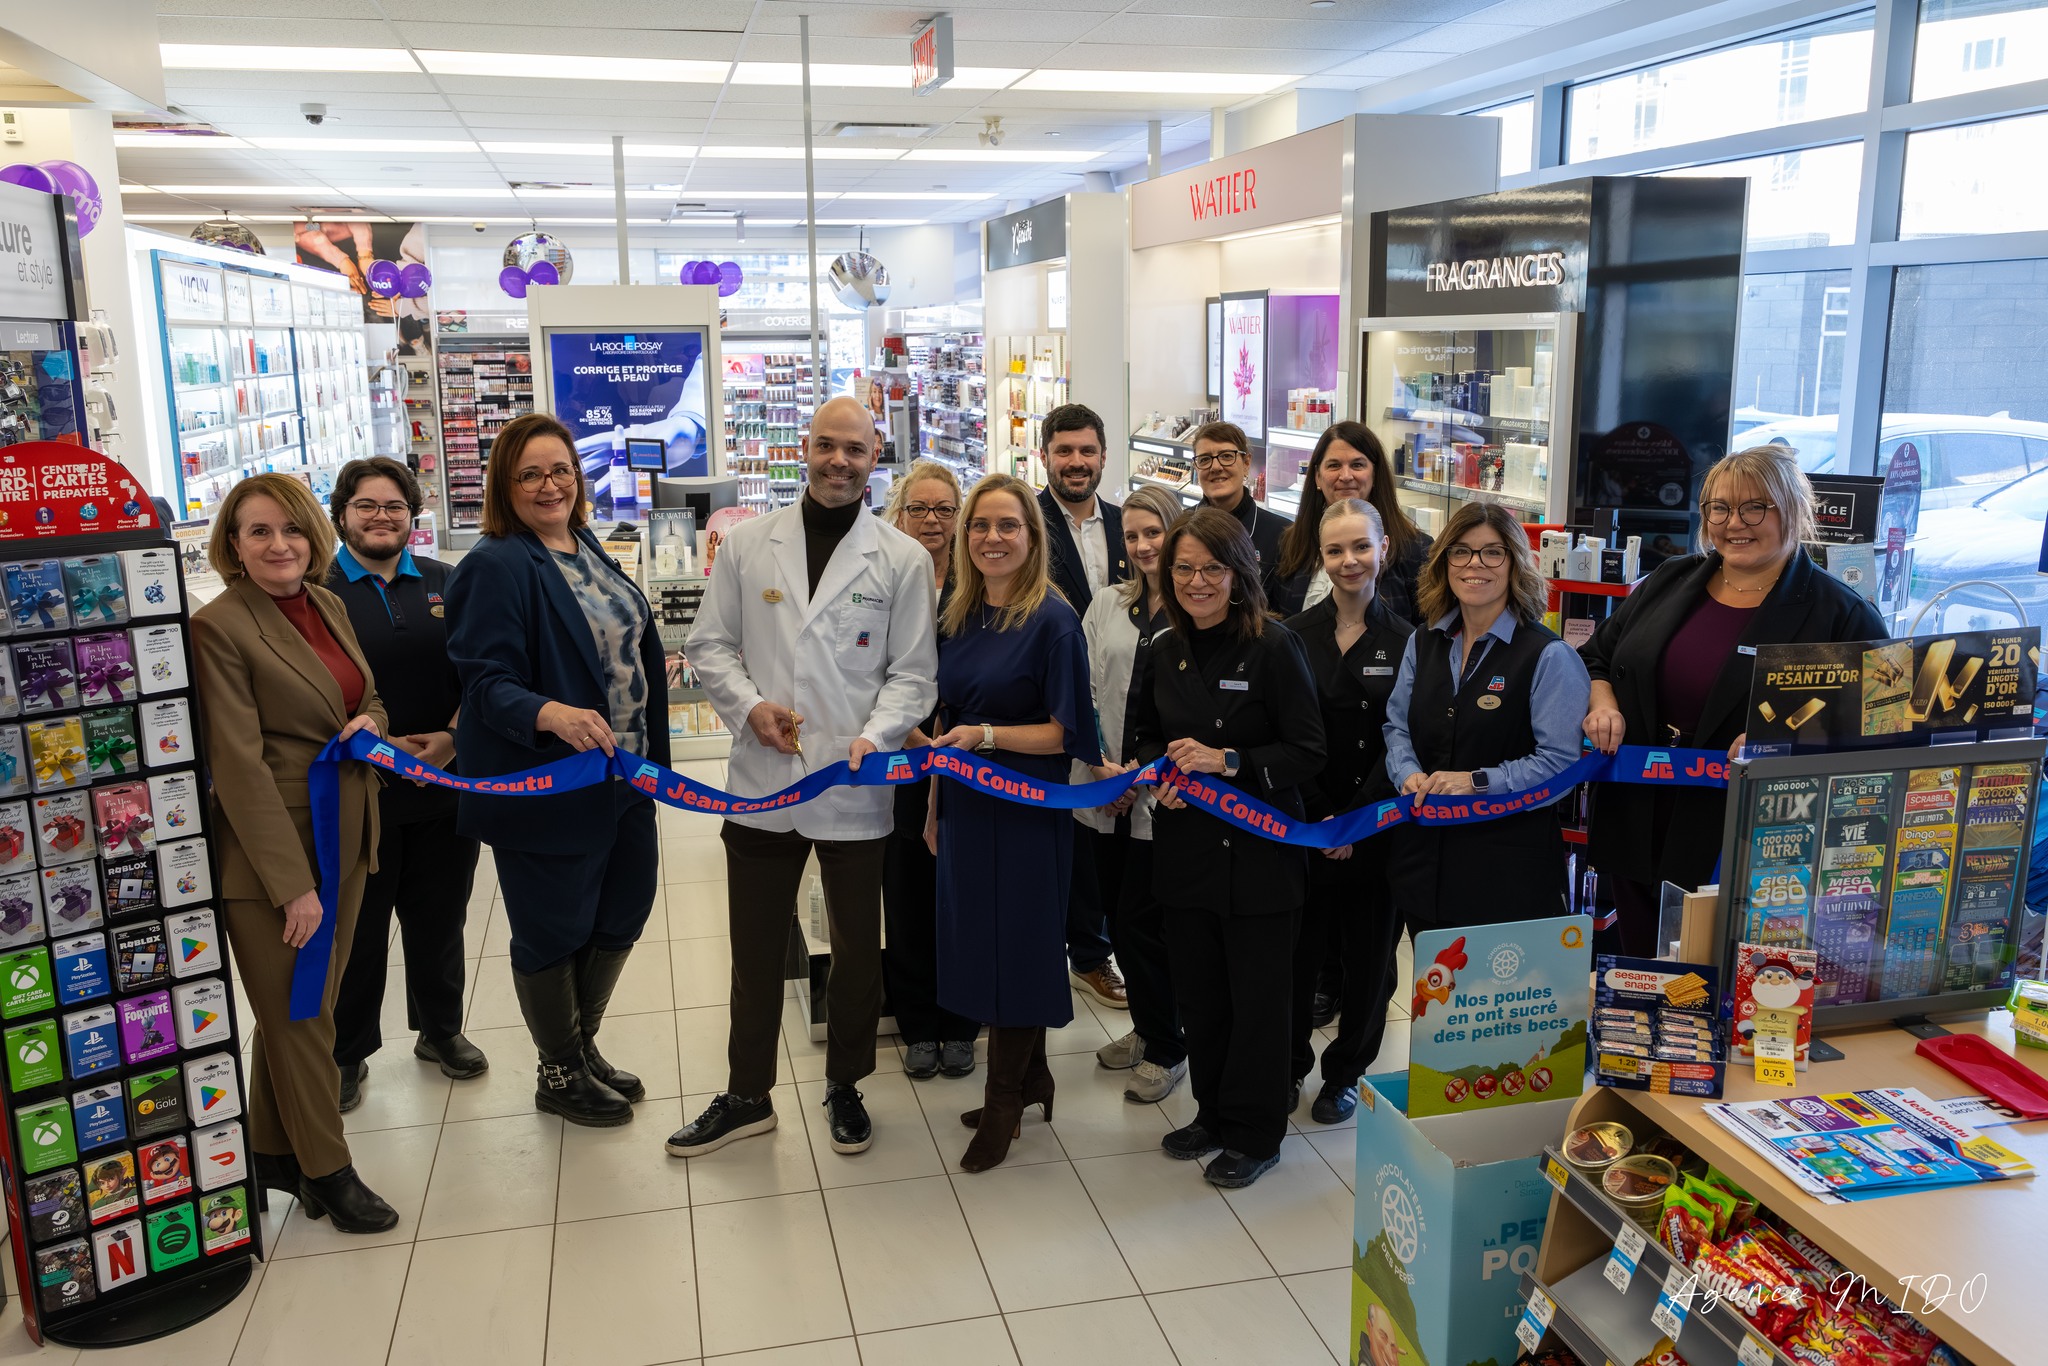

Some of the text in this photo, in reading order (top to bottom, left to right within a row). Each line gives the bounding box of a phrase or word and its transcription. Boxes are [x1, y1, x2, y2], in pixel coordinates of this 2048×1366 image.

[1190, 168, 1257, 221] WATIER
[18, 261, 53, 289] et style
[1426, 252, 1565, 292] FRAGRANCES
[179, 275, 209, 304] VICHY
[372, 278, 392, 289] moi
[1229, 315, 1261, 335] WATIER
[15, 329, 39, 344] Lecture
[590, 342, 663, 352] LA ROCHE POSAY
[573, 363, 683, 374] CORRIGE ET PROTÈGE
[608, 373, 650, 382] LA PEAU
[91, 462, 107, 472] DE
[42, 472, 108, 487] CARTES
[43, 484, 110, 500] PRÉPAYÉES
[666, 512, 693, 520] WATIER
[1577, 555, 1590, 571] ck
[28, 573, 42, 585] You
[97, 645, 112, 658] You
[1988, 644, 2021, 667] 20
[1766, 669, 1859, 685] PESANT D'OR
[1987, 674, 2019, 683] LINGOTS
[1985, 682, 2017, 696] D'OR
[405, 764, 553, 793] Jean Coutu
[921, 751, 1046, 801] Jean Coutu
[1942, 772, 1953, 781] As
[1773, 783, 1789, 791] 000
[1978, 788, 1991, 799] 20
[666, 782, 801, 812] Jean Coutu
[1161, 767, 1288, 839] Jean Coutu
[1410, 787, 1551, 820] Jean Coutu
[1910, 794, 1949, 805] SCRABBLE
[1759, 792, 1818, 823] 30X
[1979, 809, 2020, 817] MILLIONS
[1756, 837, 1761, 846] 1
[1762, 835, 1781, 845] 000
[1783, 833, 1803, 844] 000
[1844, 826, 1866, 841] VIE
[1905, 829, 1936, 843] bingo
[1762, 843, 1802, 858] ULTRA
[1831, 851, 1876, 866] ARGENT
[1965, 855, 2004, 867] RETOUR
[108, 861, 148, 876] ROBLOX
[1760, 874, 1801, 887] GIGA
[1829, 875, 1873, 887] MEGA
[1752, 884, 1807, 905] 360
[1894, 890, 1942, 903] CONNEXION
[1826, 900, 1873, 914] AMÉTHYSTE
[148, 925, 161, 933] $25
[173, 921, 211, 935] Google Play
[119, 935, 161, 950] ROBLOX
[1487, 942, 1526, 961] CHOCOLATERIE
[71, 971, 96, 980] PlayStation
[1614, 971, 1658, 982] sesame
[1624, 981, 1657, 991] snaps
[6, 992, 51, 1007] CARTE-CADEAU
[12, 992, 26, 1000] GIFT
[184, 996, 208, 1006] Google
[1455, 986, 1552, 1008] Nos poules
[124, 1002, 169, 1024] FORTNITE
[1447, 1000, 1558, 1025] en ont sucré
[1434, 1017, 1569, 1044] des petits becs
[82, 1043, 108, 1055] PlayStation
[1618, 1058, 1637, 1067] 1.29
[193, 1068, 230, 1083] Google Play
[1763, 1068, 1785, 1078] 0.75
[155, 1097, 177, 1111] Gold
[1903, 1098, 1934, 1117] Jean
[1932, 1115, 1971, 1139] Coutu
[1555, 1166, 1566, 1177] 4.49
[177, 1179, 188, 1187] 25
[1514, 1179, 1545, 1190] Depuis
[1375, 1163, 1428, 1233] CHOCOLATERIE
[1520, 1188, 1544, 1197] Since
[124, 1198, 135, 1206] 50
[52, 1224, 71, 1232] STEAM
[237, 1229, 247, 1237] 10
[1484, 1238, 1496, 1247] LA
[1668, 1214, 1687, 1263] Twizzlers
[1787, 1233, 1840, 1281] Skittles
[1394, 1266, 1416, 1285] PÈRES
[1692, 1259, 1759, 1317] Skittles
[62, 1295, 80, 1303] STEAM
